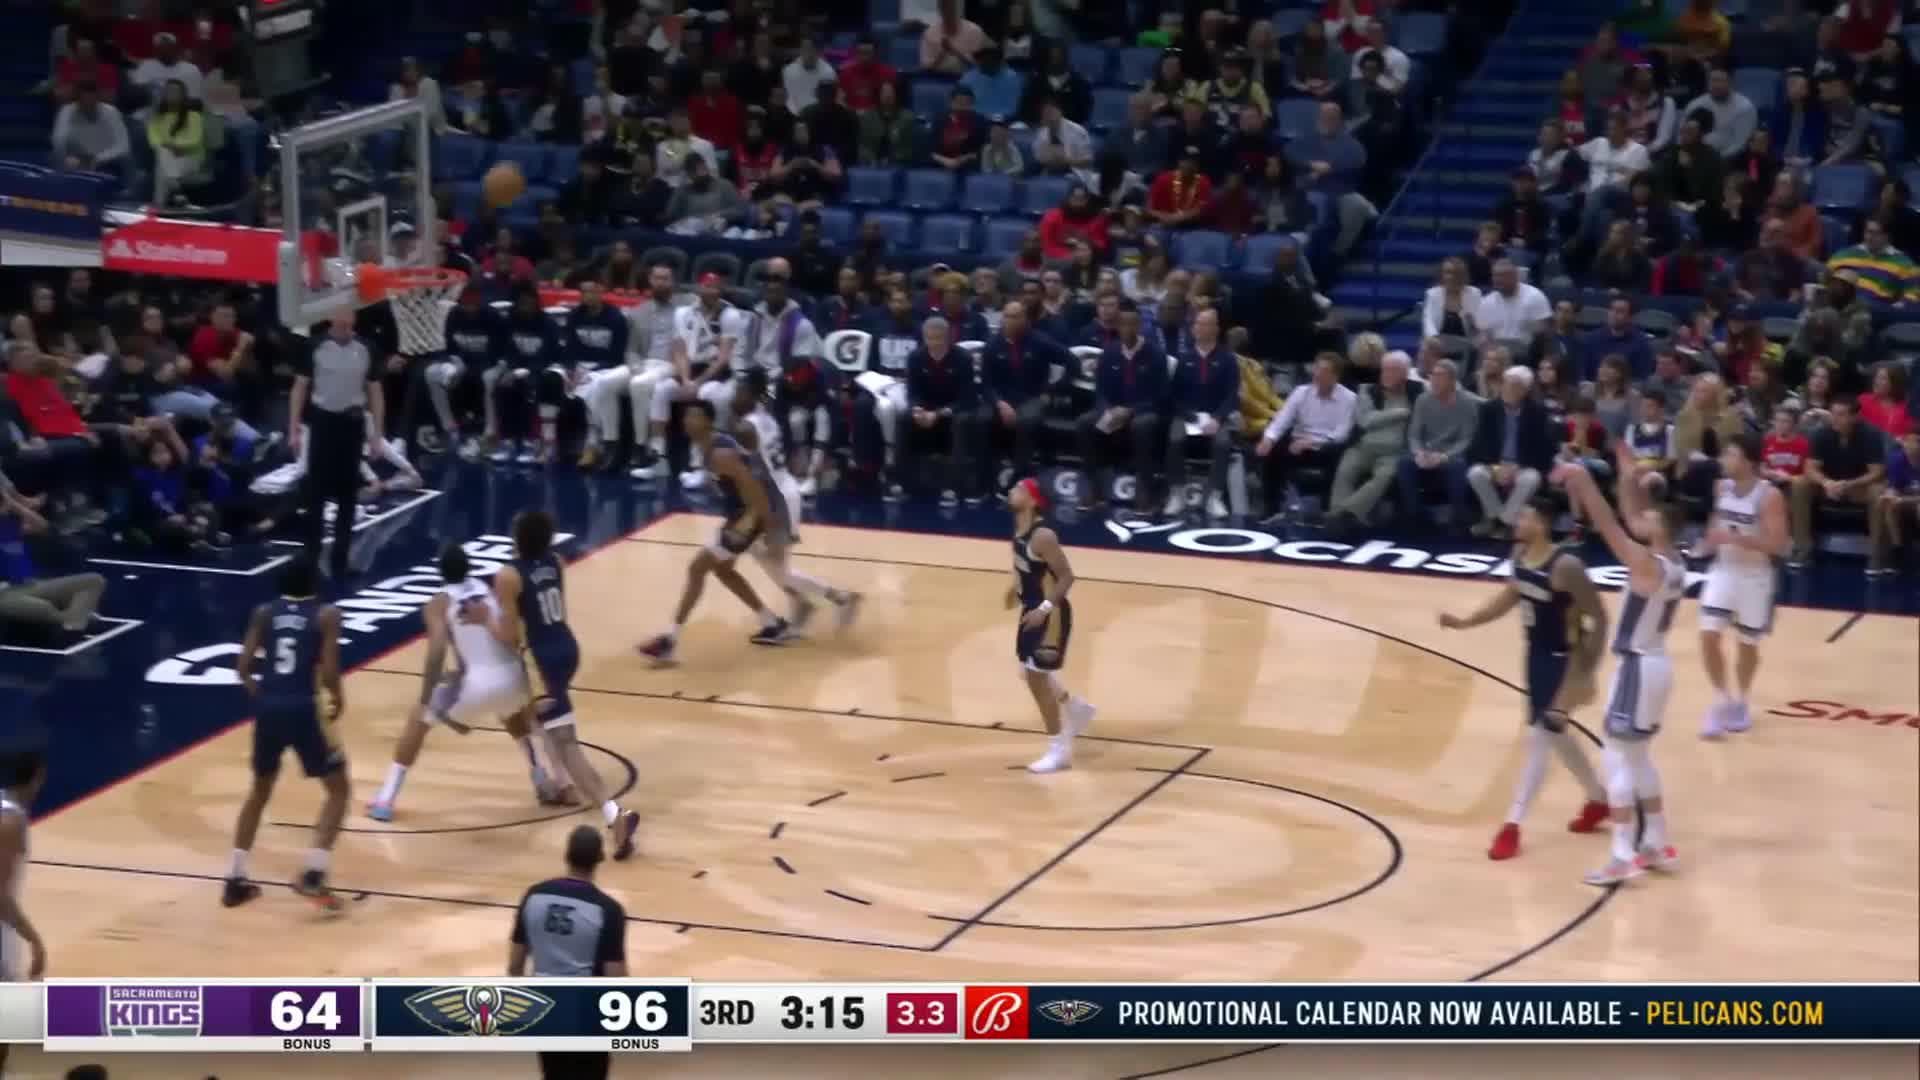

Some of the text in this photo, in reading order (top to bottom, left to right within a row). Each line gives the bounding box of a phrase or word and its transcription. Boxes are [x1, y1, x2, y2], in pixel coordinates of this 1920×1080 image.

[835, 335, 863, 366] G
[1054, 471, 1078, 494] G
[1113, 475, 1136, 499] G
[537, 587, 563, 626] 10
[274, 636, 297, 675] 5
